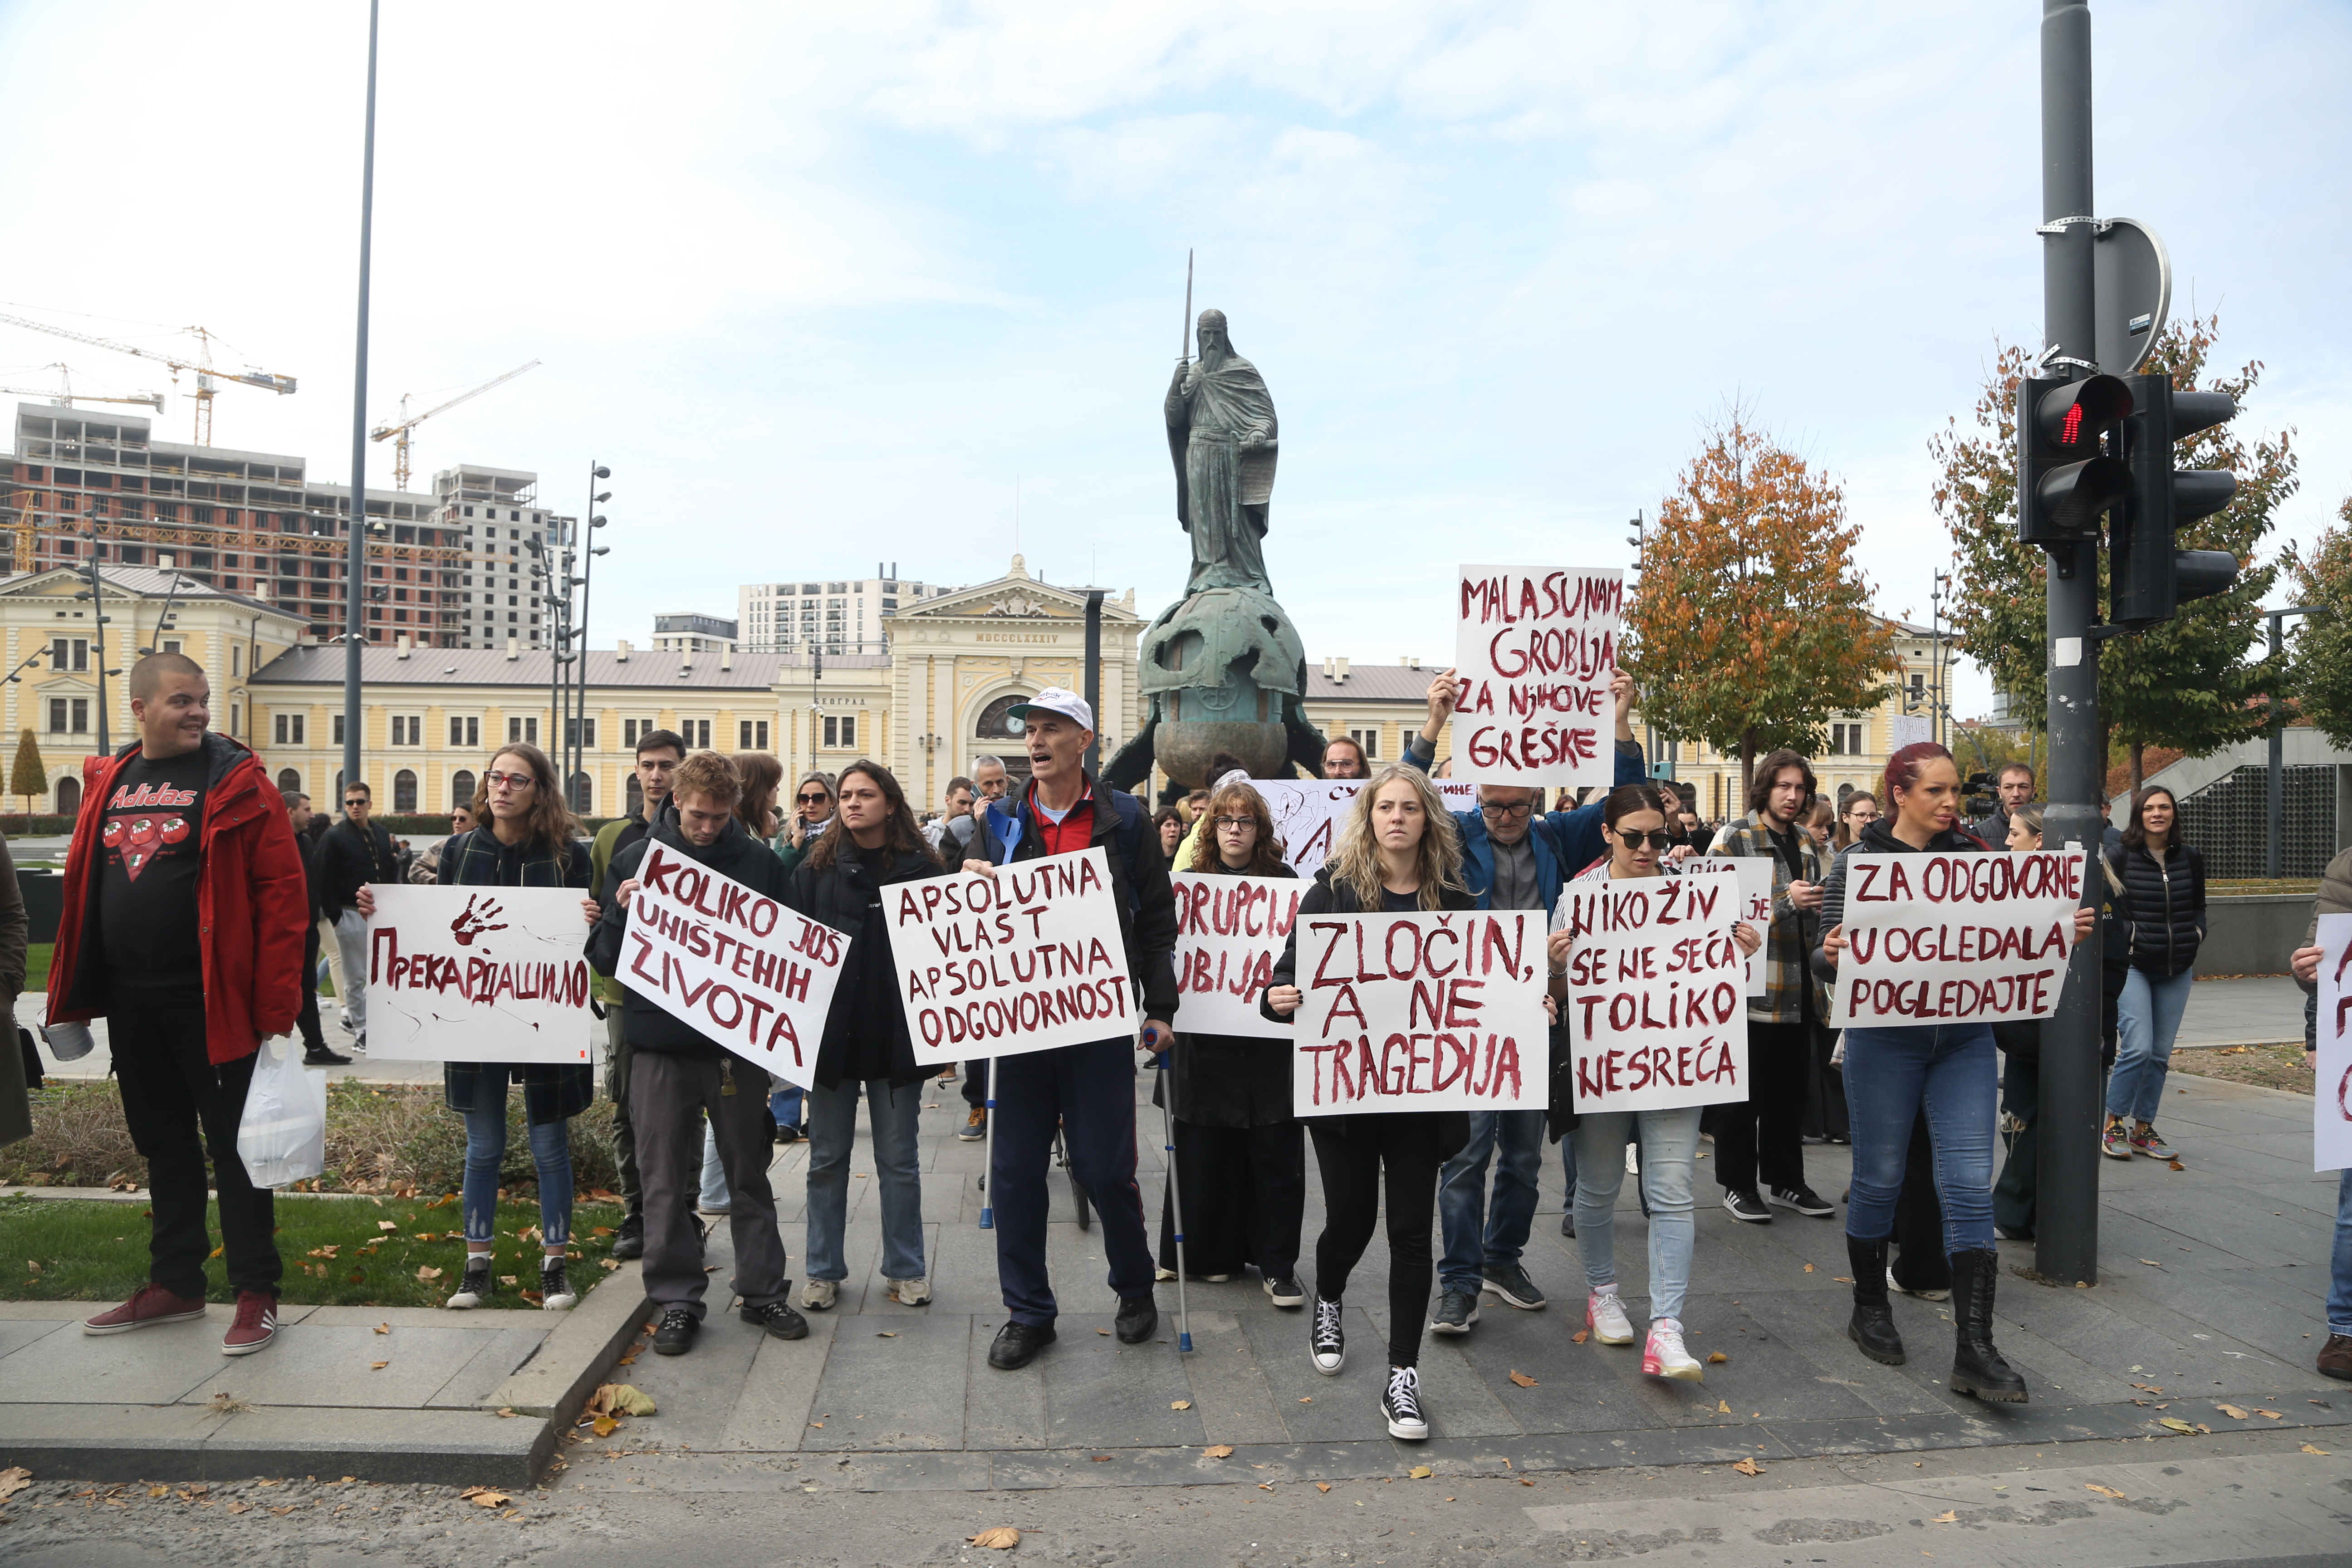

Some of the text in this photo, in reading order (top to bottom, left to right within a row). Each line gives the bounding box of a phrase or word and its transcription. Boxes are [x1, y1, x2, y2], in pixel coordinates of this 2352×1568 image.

[976, 633, 1058, 643] MDCCCLXXXIV
[1454, 678, 1494, 715] ZA
[1469, 721, 1597, 771] GREŠKE
[106, 782, 198, 810] Adidas
[643, 849, 840, 966] KOLIKO JOŠ
[900, 858, 1101, 926] APSOLUTNA
[1855, 854, 2083, 904] ZA ODGOVORNE
[1172, 882, 1298, 936] ORUPCIJ
[637, 896, 811, 1003] UNIŠTENIH
[911, 938, 1112, 1002] APSOLUTNA
[1311, 914, 1533, 990] ZLOČIN,
[1570, 949, 1608, 986] SE
[1619, 947, 1657, 982] NE
[1667, 927, 1737, 973] SEĆA
[1850, 921, 2067, 965] U OGLEDALA
[632, 932, 802, 1067] ŽIVOTA
[920, 976, 1126, 1047] ODGOVORNOST
[1321, 979, 1485, 1038] A NE
[1850, 970, 2054, 1018] POGLEDAJTE
[1300, 1033, 1522, 1105] TRAGEDIJA
[1577, 1036, 1736, 1099] NESREĆA
